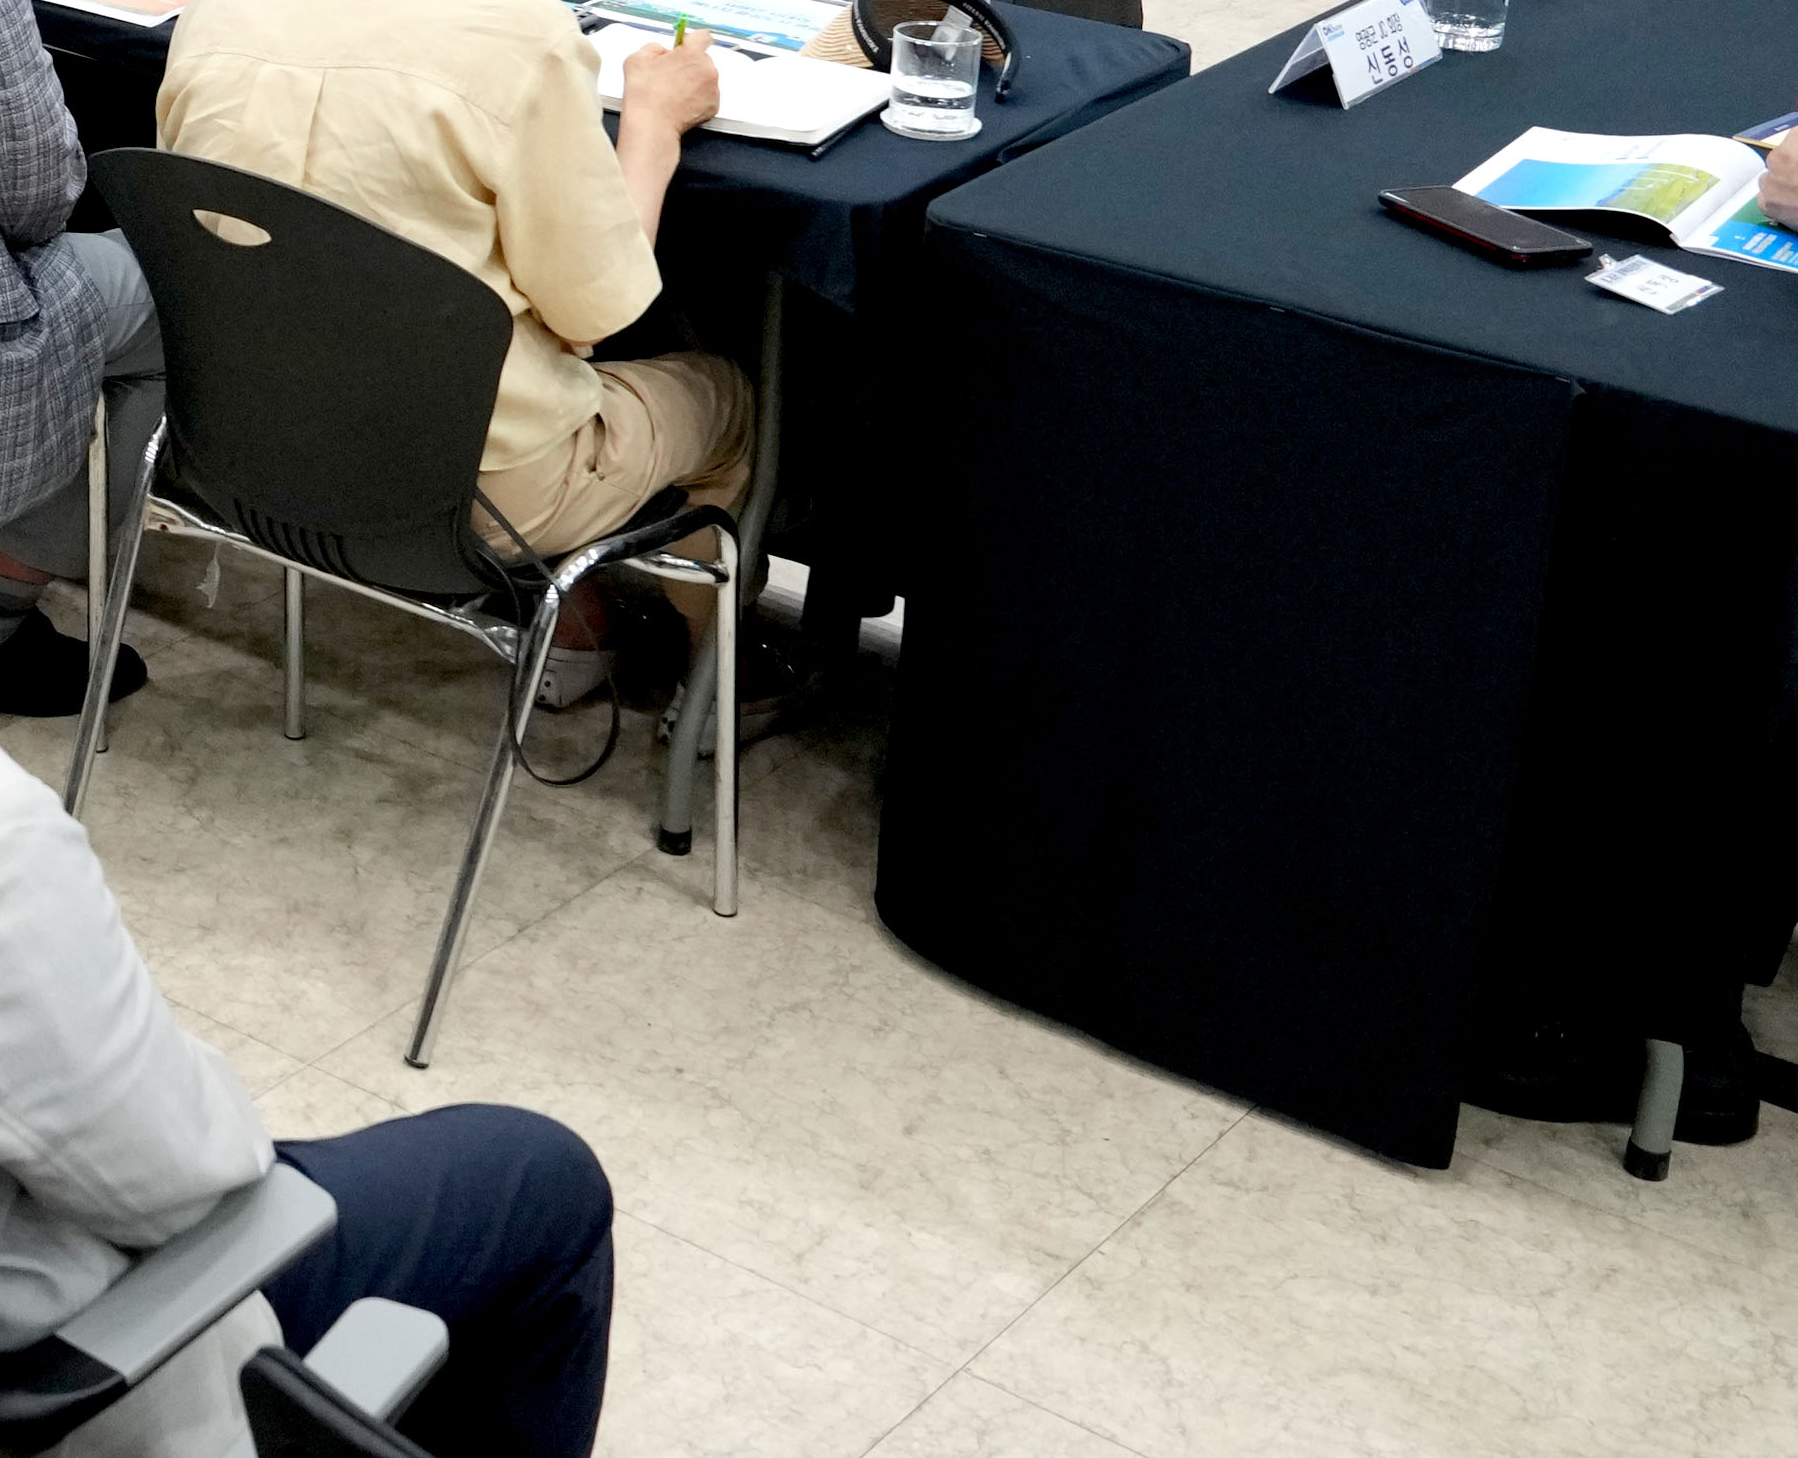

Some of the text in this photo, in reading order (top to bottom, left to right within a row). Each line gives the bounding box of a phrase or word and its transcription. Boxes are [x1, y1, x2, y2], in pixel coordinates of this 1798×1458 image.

[1356, 25, 1378, 50] 영광군
[1387, 13, 1403, 34] 회장
[1367, 36, 1413, 85] 신동성
